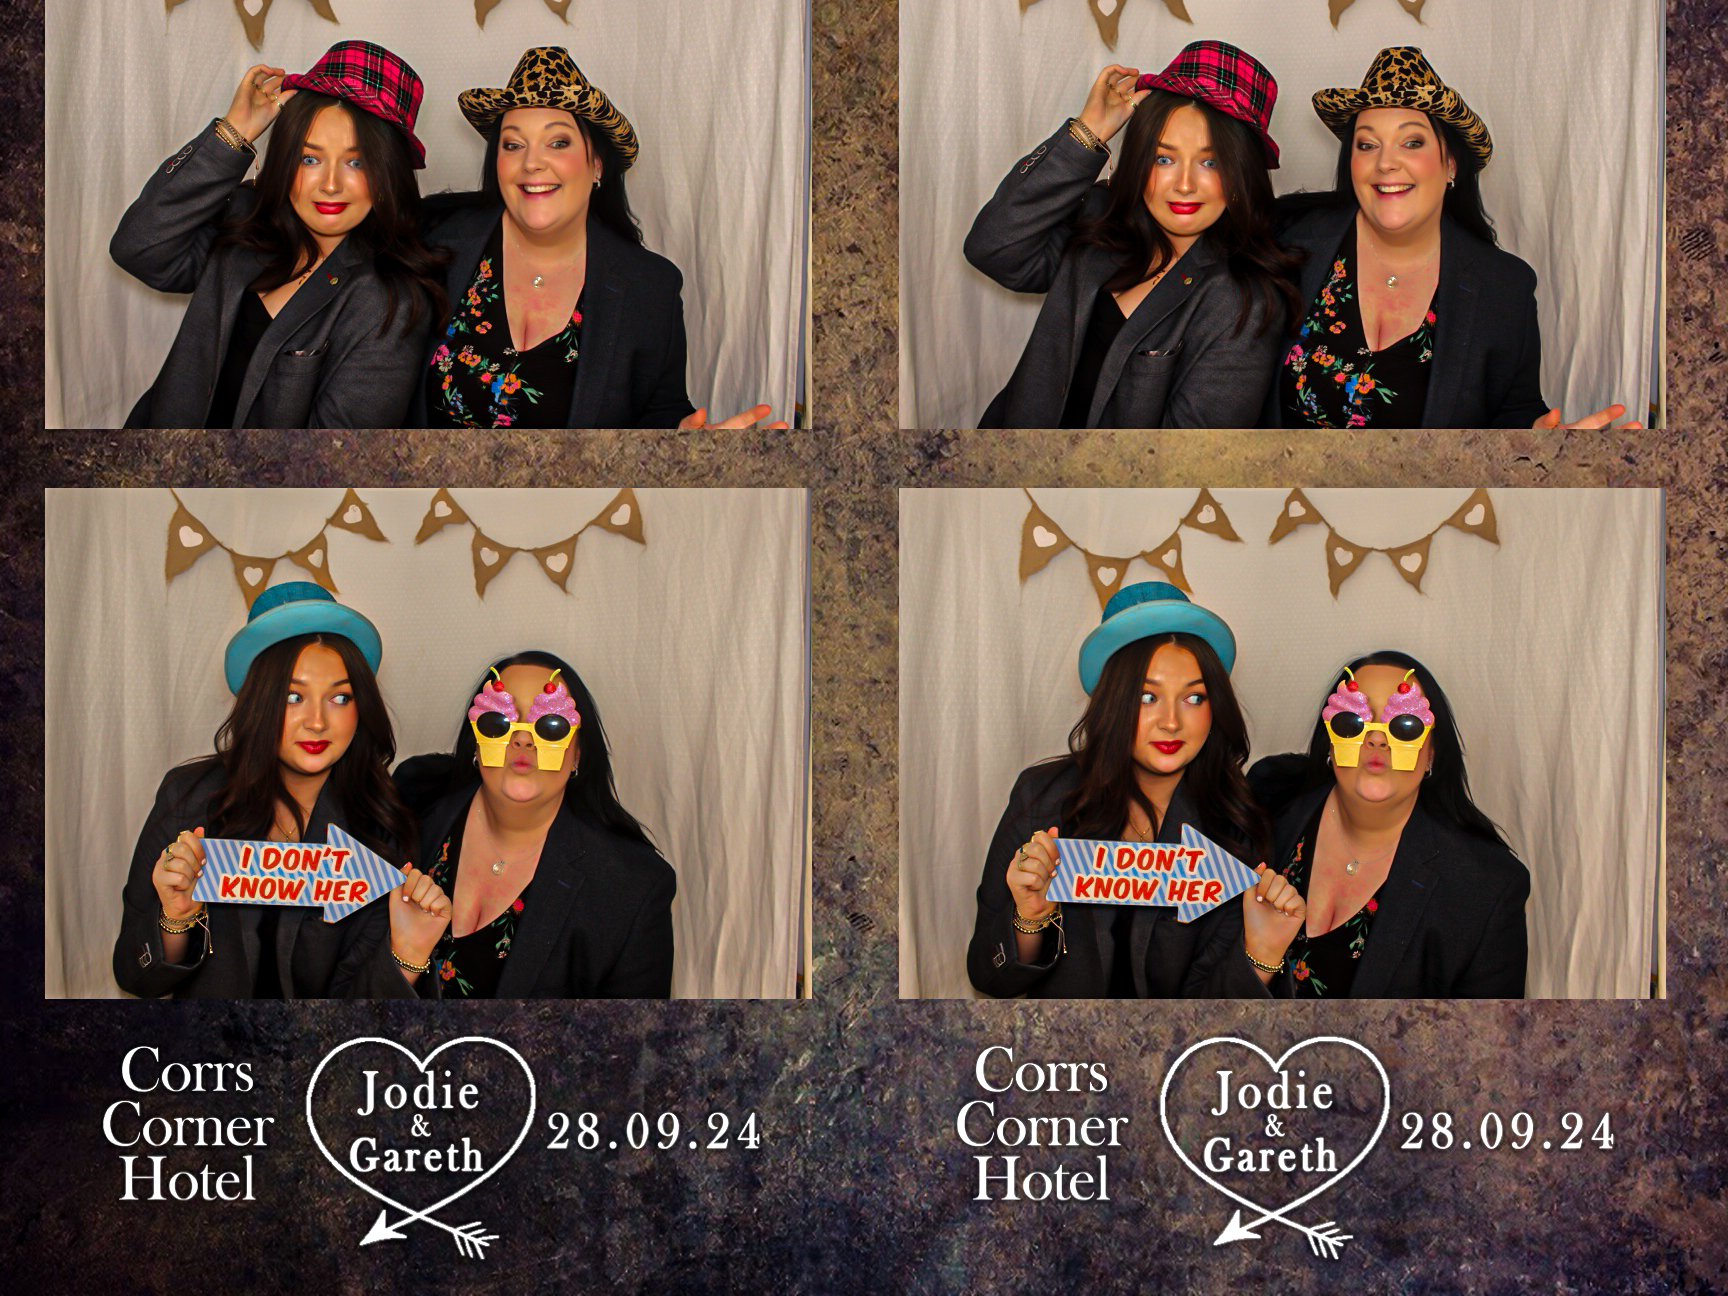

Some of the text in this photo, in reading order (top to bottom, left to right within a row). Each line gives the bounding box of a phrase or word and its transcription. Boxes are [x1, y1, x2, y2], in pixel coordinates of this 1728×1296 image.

[241, 847, 351, 872] I DON'T
[1095, 847, 1205, 872] I DON'T
[221, 875, 370, 904] KNOW HER
[1075, 875, 1224, 904] KNOW HER
